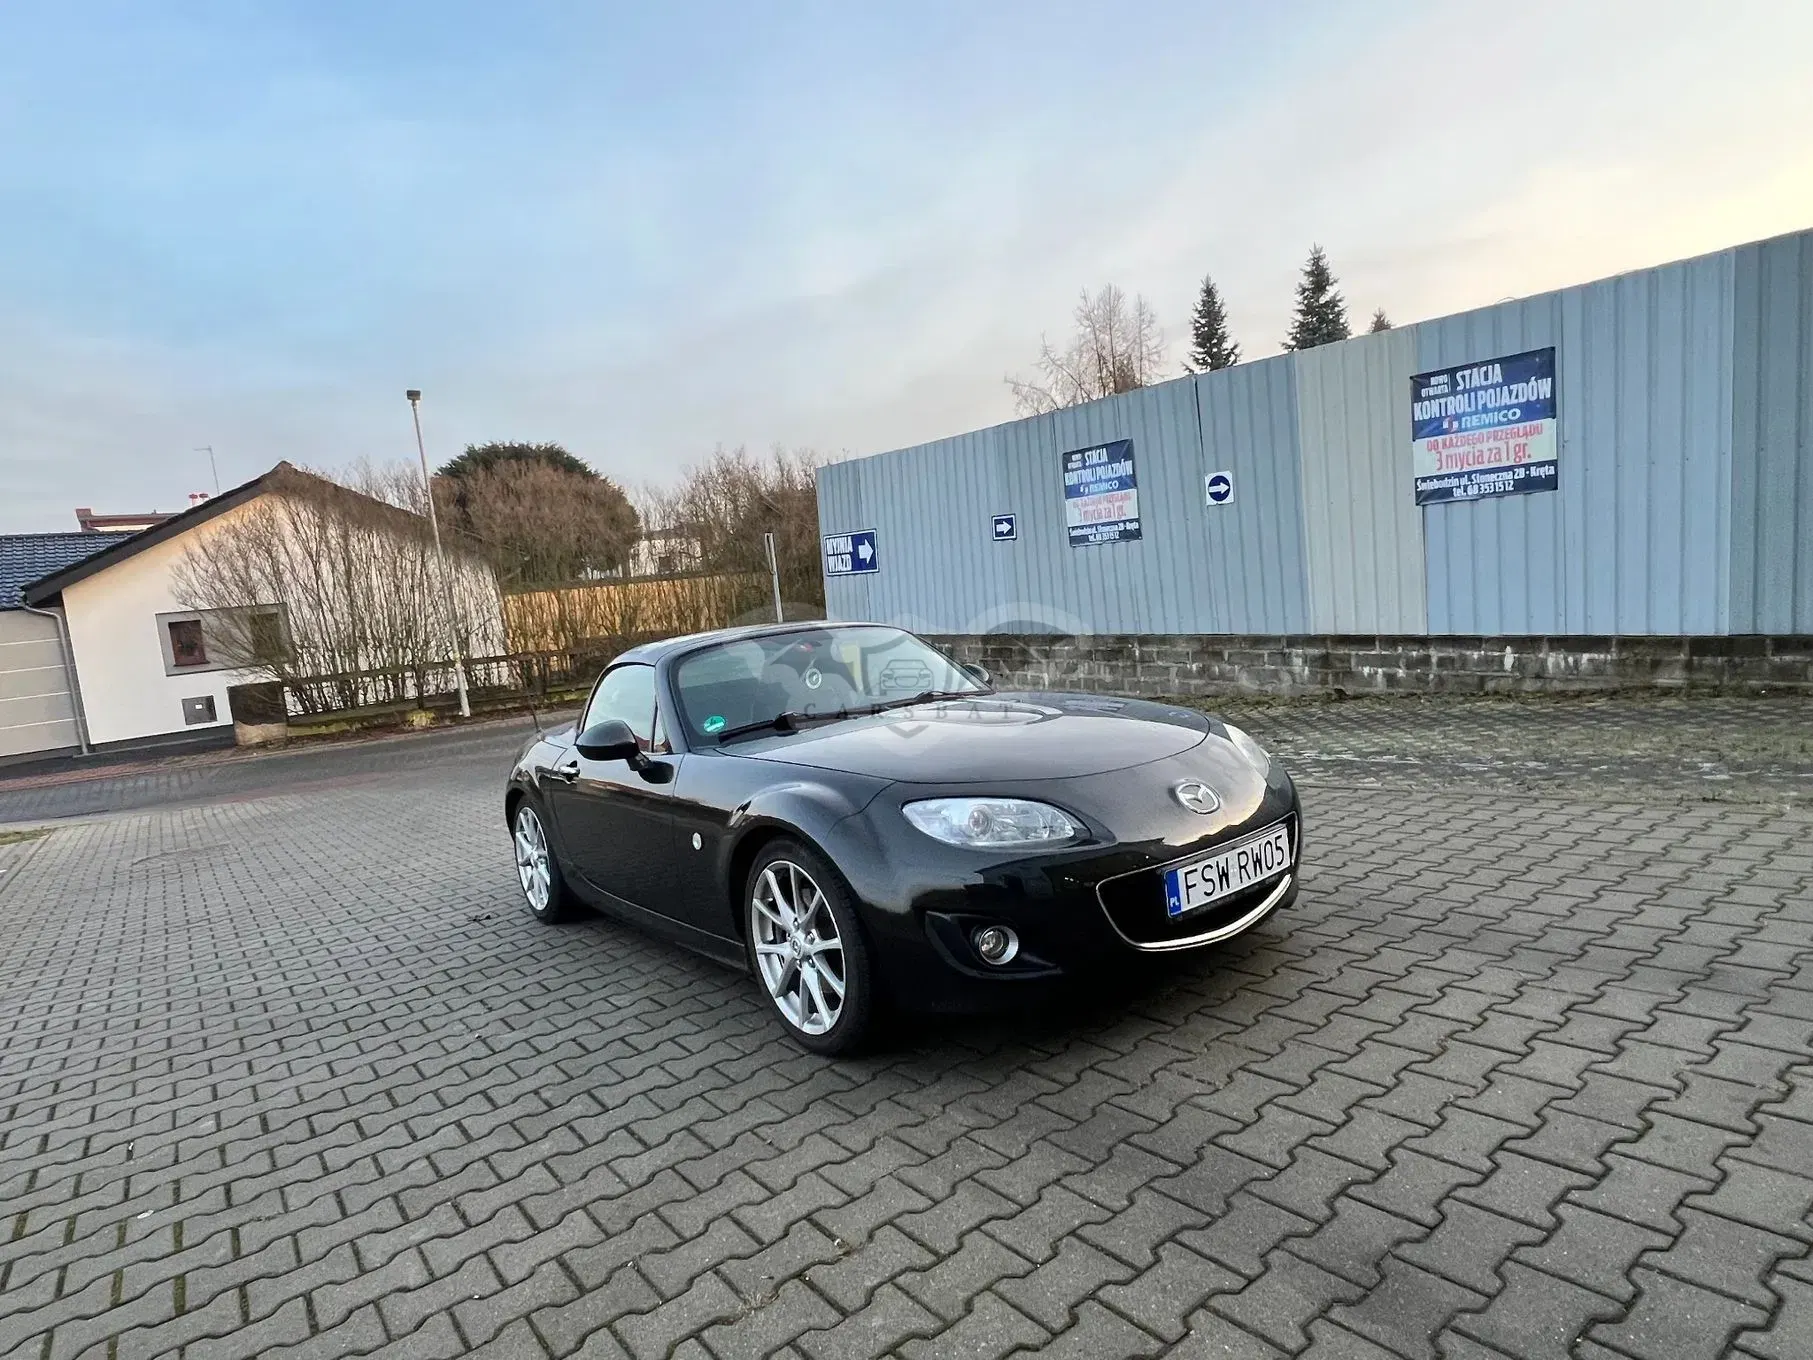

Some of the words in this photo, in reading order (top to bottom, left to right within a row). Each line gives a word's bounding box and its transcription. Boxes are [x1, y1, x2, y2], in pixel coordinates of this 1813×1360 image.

[1456, 364, 1503, 391] STACJA
[1413, 391, 1476, 421] KONTROLI
[1477, 376, 1552, 410] POJAZDÓW
[1461, 408, 1521, 429] REMICO
[1435, 451, 1443, 471] 3
[1445, 446, 1485, 471] mycia
[1487, 447, 1502, 464] za
[1505, 441, 1511, 461] 1
[1514, 441, 1532, 464] gr.
[1452, 485, 1467, 498] tel.
[1183, 857, 1231, 905] FSW
[1237, 834, 1285, 884] RW05
[1169, 896, 1180, 908] PL
